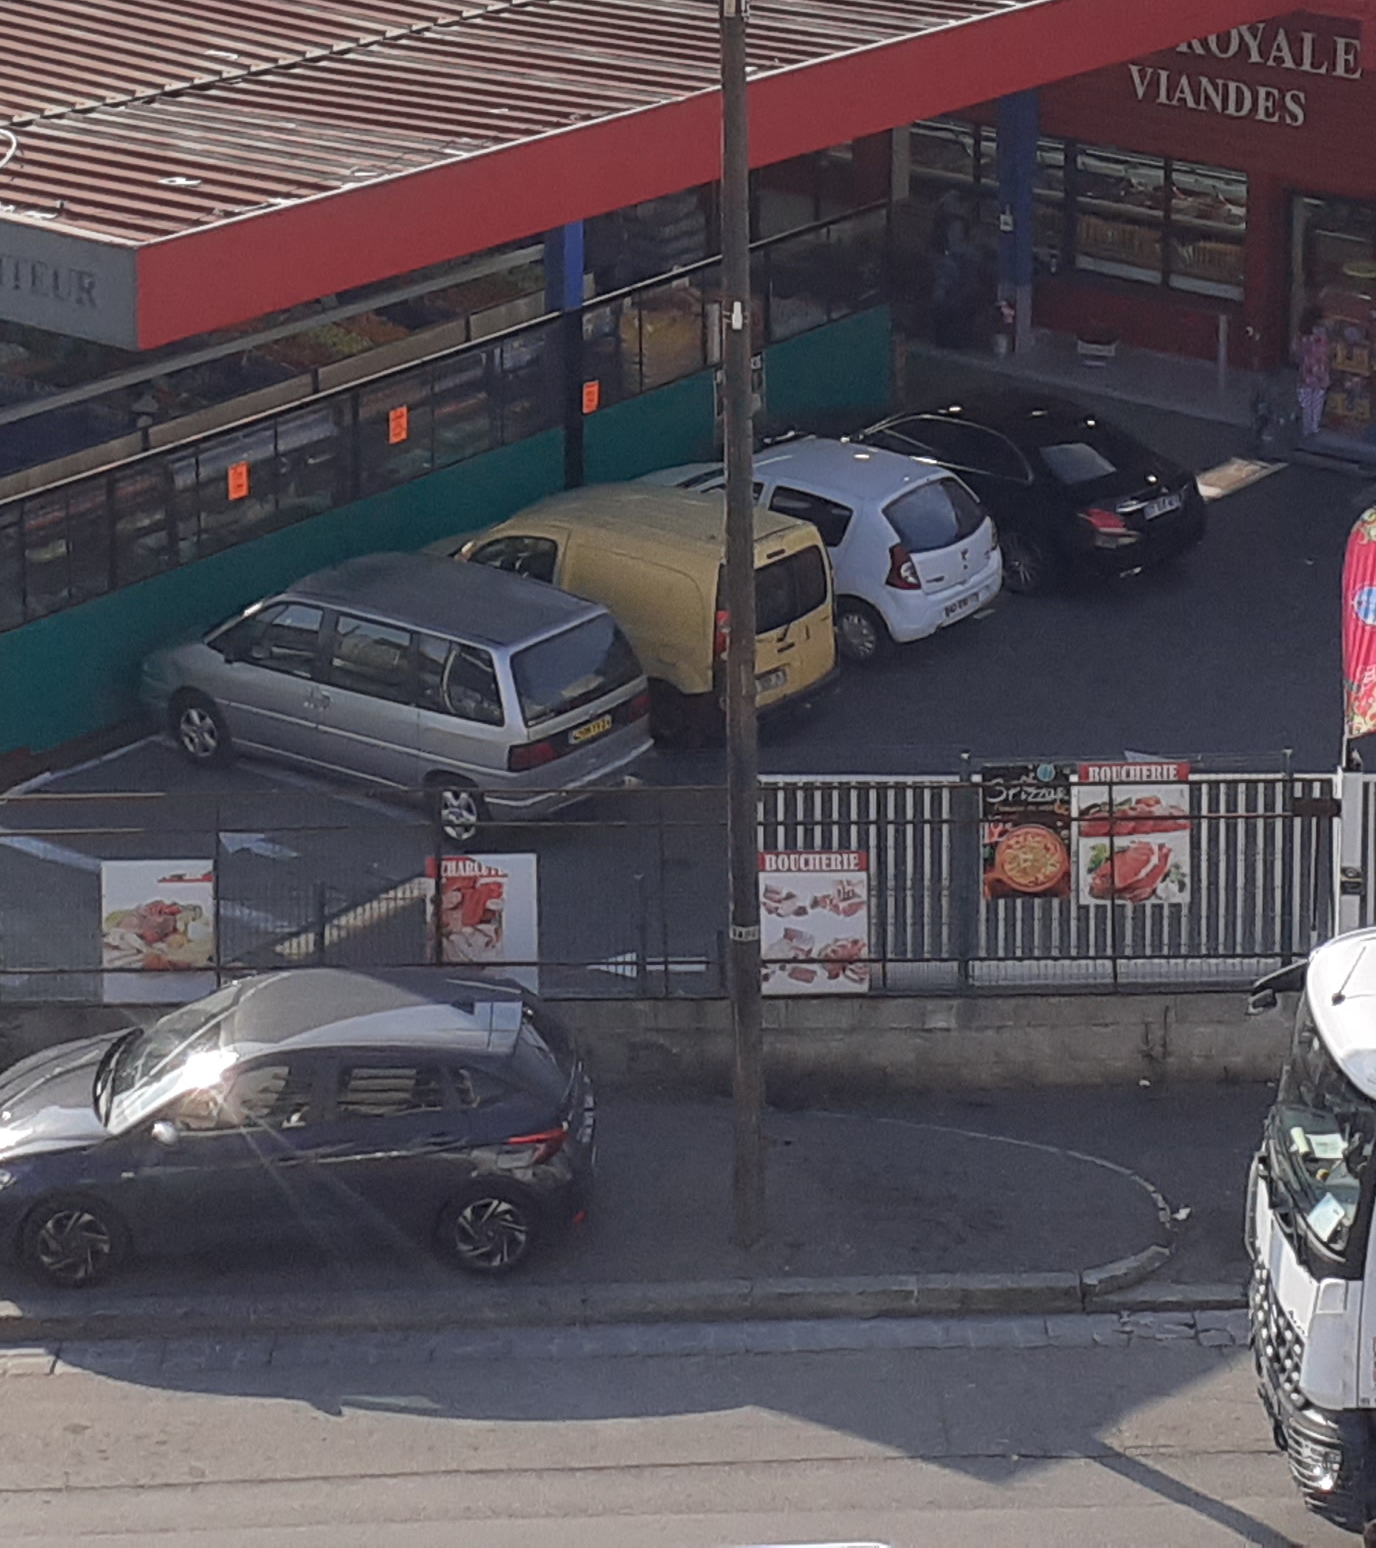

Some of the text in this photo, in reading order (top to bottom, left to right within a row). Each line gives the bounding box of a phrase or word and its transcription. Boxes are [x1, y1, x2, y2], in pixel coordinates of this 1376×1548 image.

[1128, 63, 1306, 127] VIANDES
[1088, 764, 1179, 782] BOUCHERIE
[764, 853, 861, 871] BOUCHERIE
